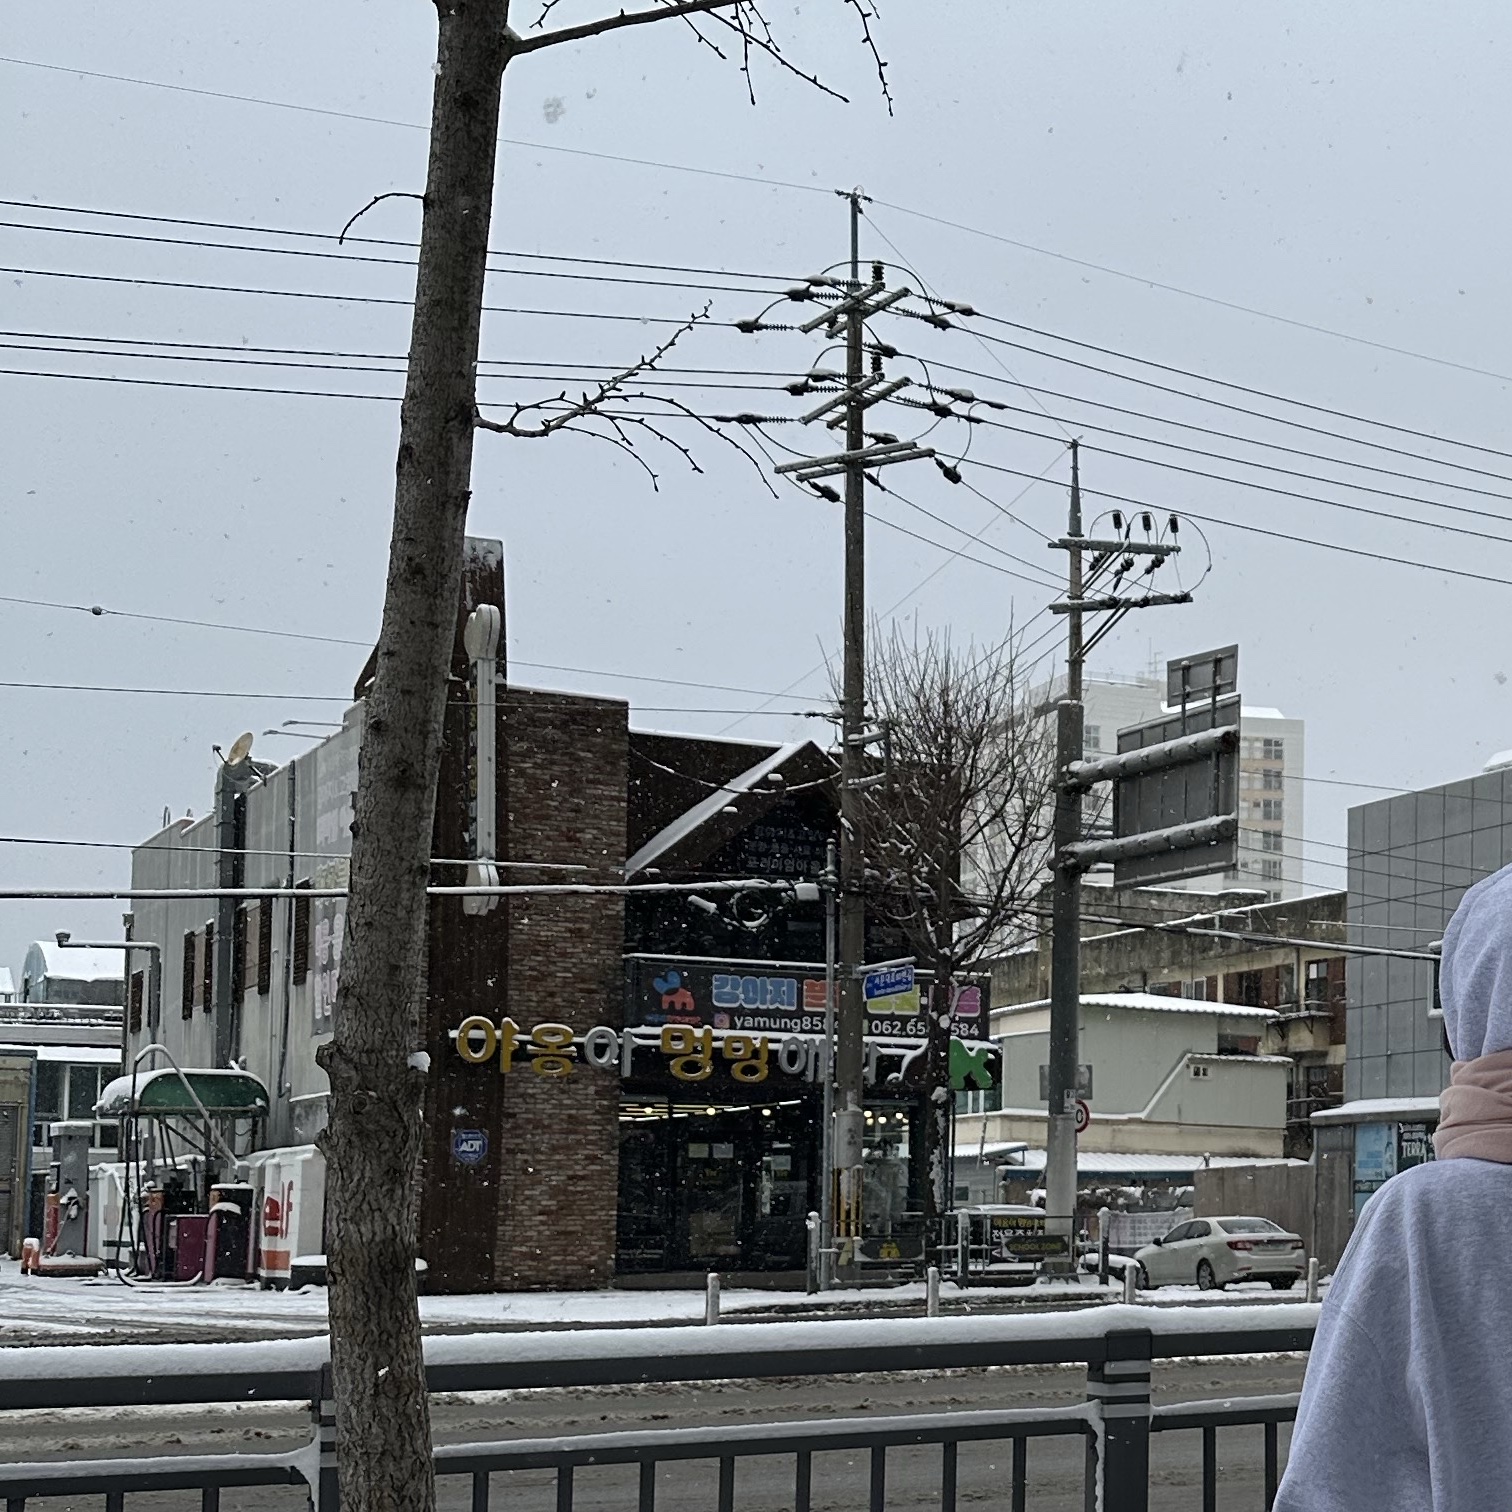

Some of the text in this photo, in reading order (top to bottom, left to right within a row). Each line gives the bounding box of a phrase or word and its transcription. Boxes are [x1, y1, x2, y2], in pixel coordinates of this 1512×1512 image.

[713, 974, 797, 1010] 강아지
[456, 1016, 638, 1078] 야옹아
[459, 1140, 482, 1152] ADT
